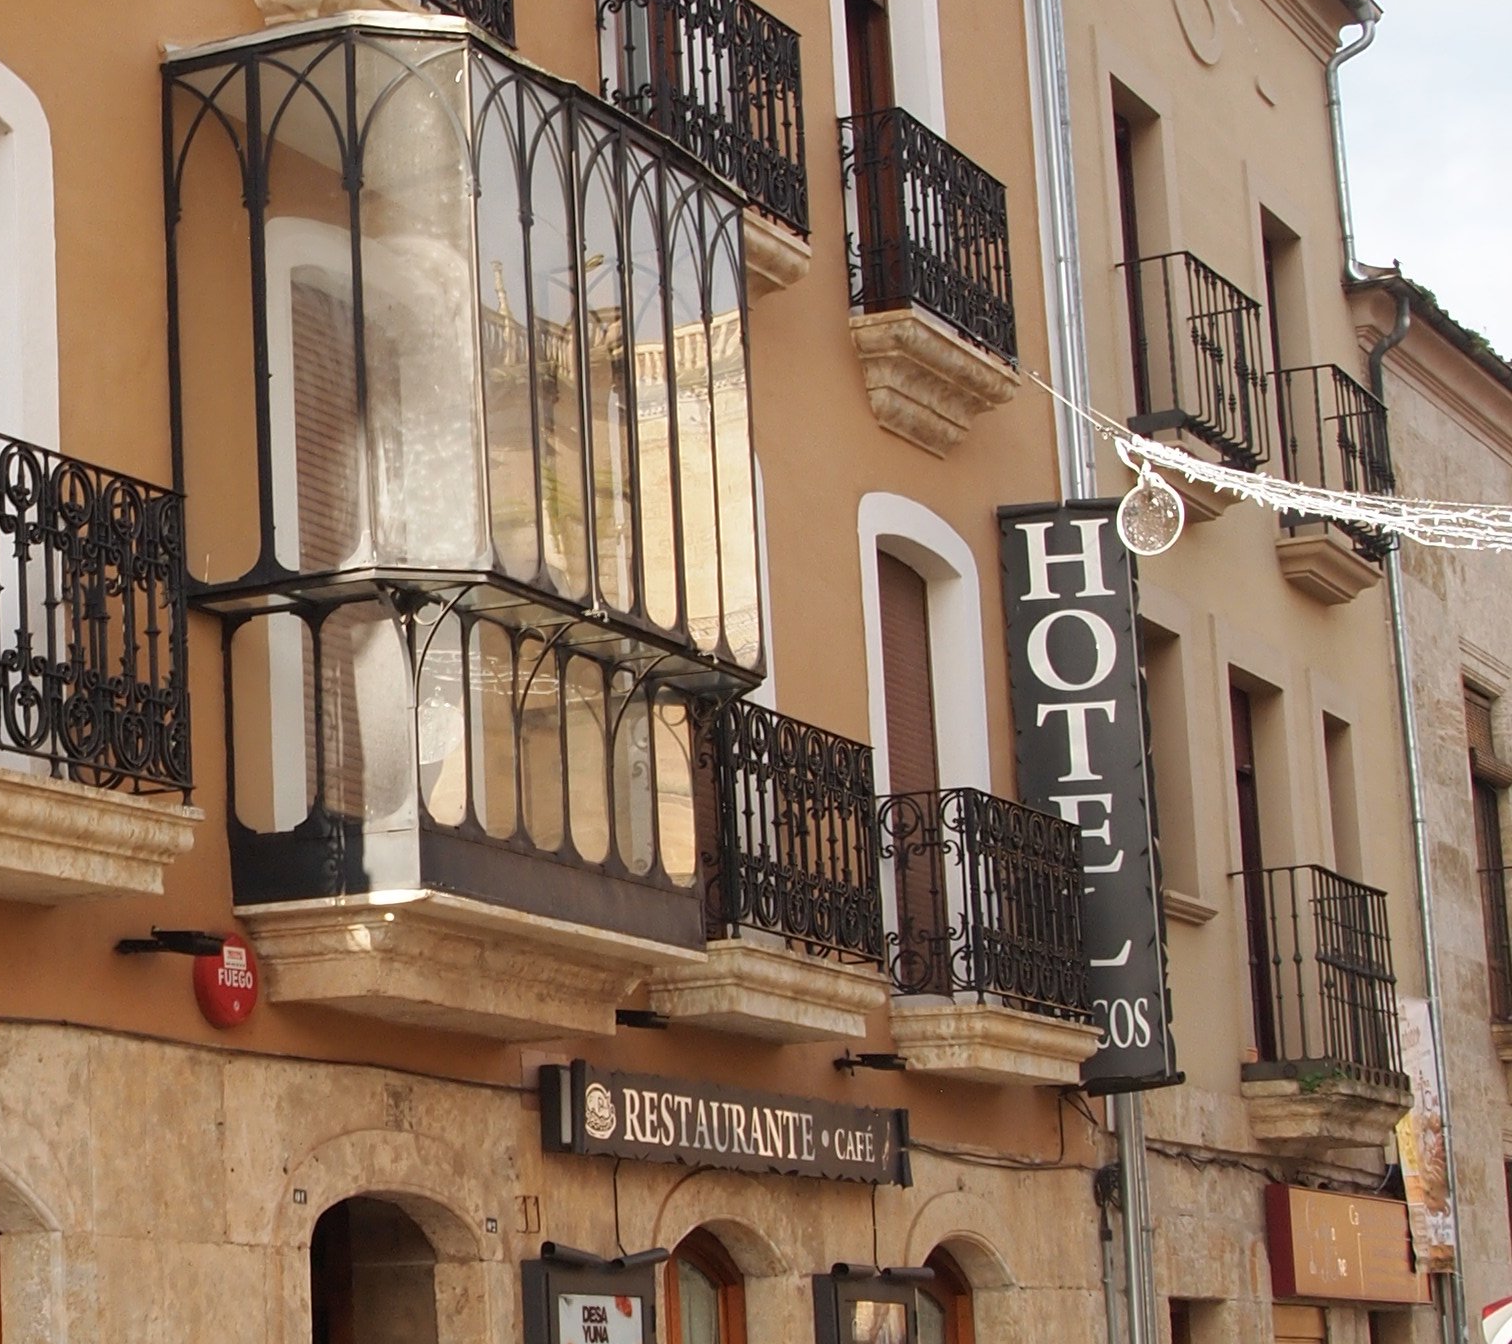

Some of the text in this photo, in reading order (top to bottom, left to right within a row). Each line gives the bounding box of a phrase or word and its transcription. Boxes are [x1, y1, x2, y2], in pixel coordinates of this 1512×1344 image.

[217, 968, 254, 989] FUEGO
[623, 1088, 876, 1163] RESTAURANTE CAFÉ
[582, 1306, 608, 1324] DESA
[582, 1325, 610, 1344] YUNA
